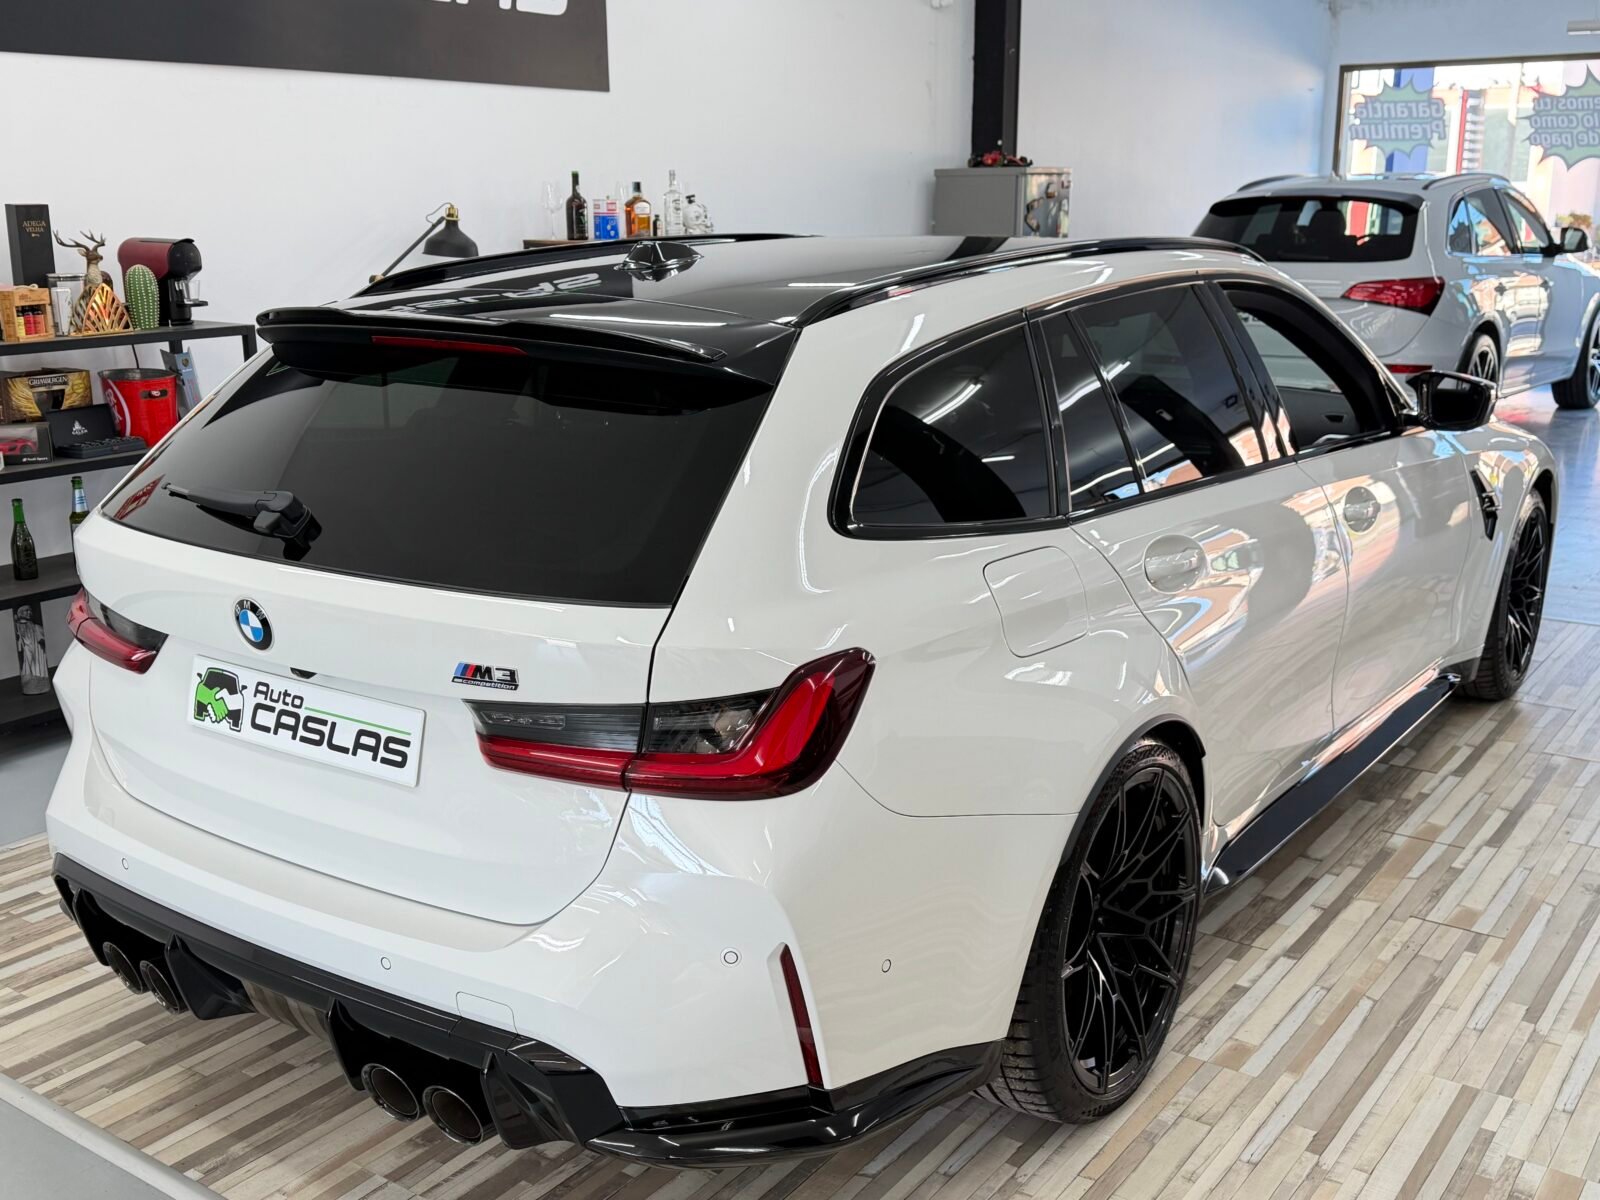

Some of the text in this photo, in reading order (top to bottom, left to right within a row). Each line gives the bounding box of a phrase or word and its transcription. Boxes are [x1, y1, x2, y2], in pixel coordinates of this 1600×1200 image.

[235, 600, 266, 620] BMW
[472, 663, 519, 684] M3
[253, 681, 305, 709] Auto
[462, 679, 516, 690] competition
[250, 702, 411, 769] CASLAS
